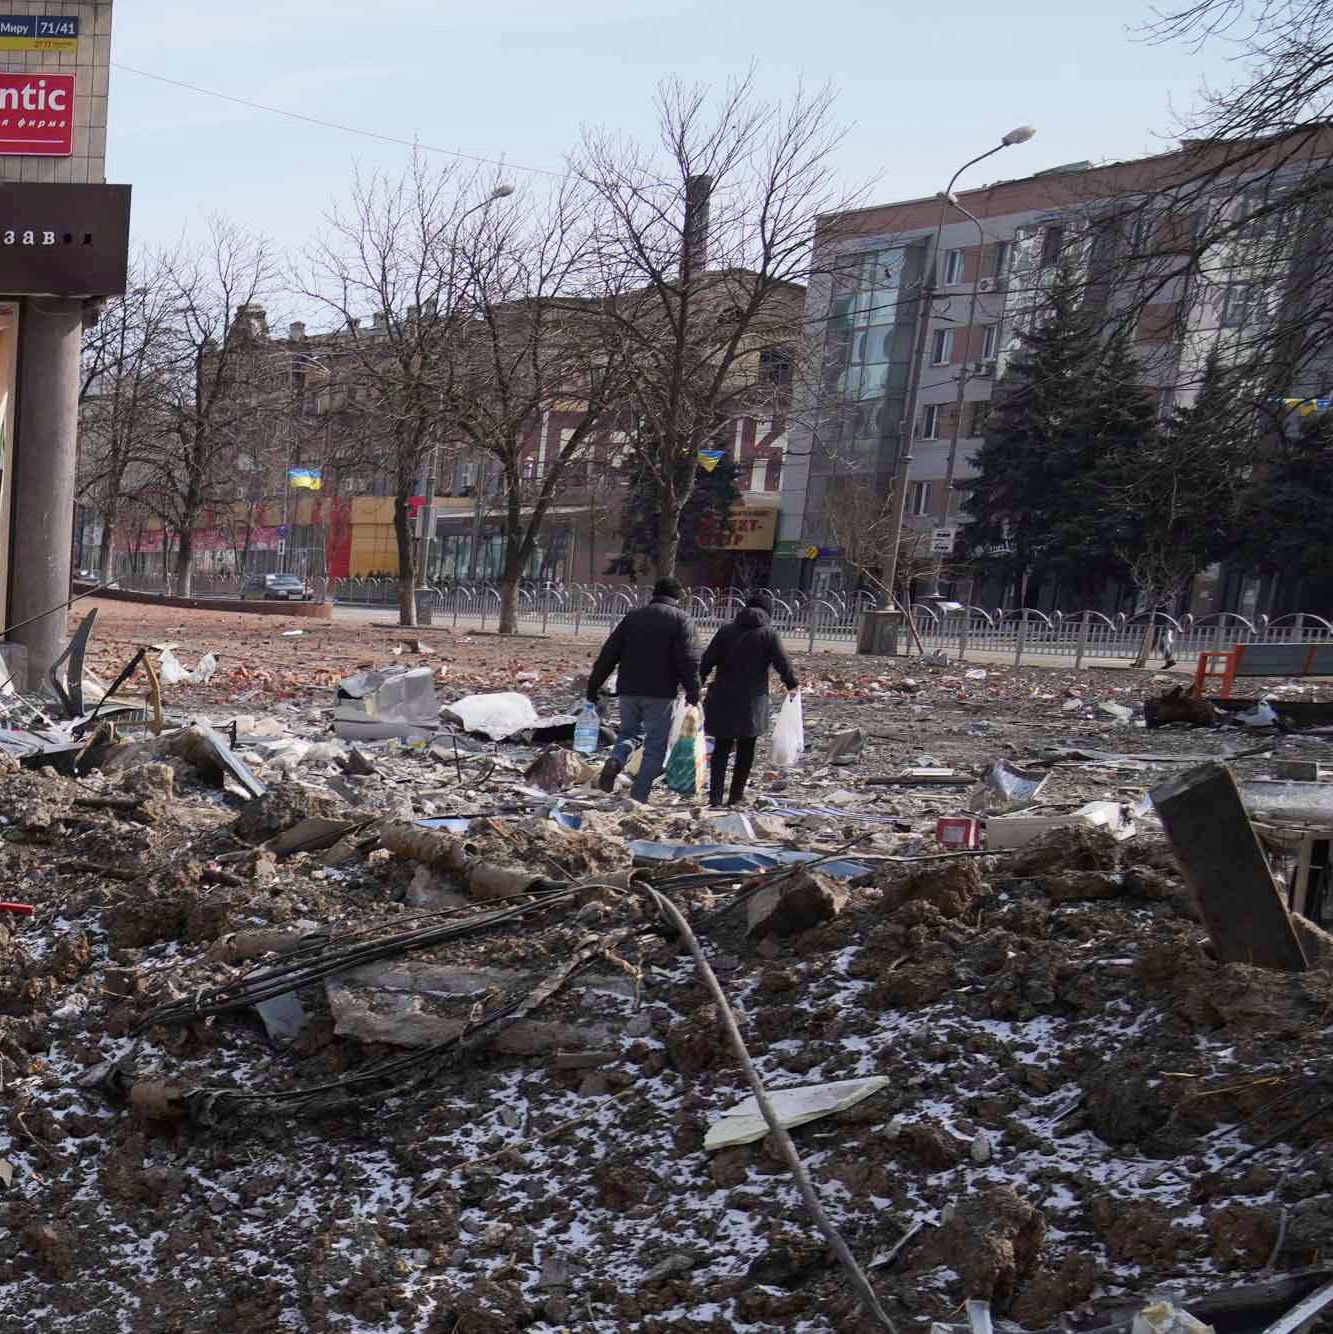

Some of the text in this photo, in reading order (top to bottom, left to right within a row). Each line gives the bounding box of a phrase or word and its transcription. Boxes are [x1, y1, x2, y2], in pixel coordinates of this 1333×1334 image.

[0, 22, 29, 34] Миру
[39, 21, 76, 34] 71/41
[16, 116, 67, 129] фирма
